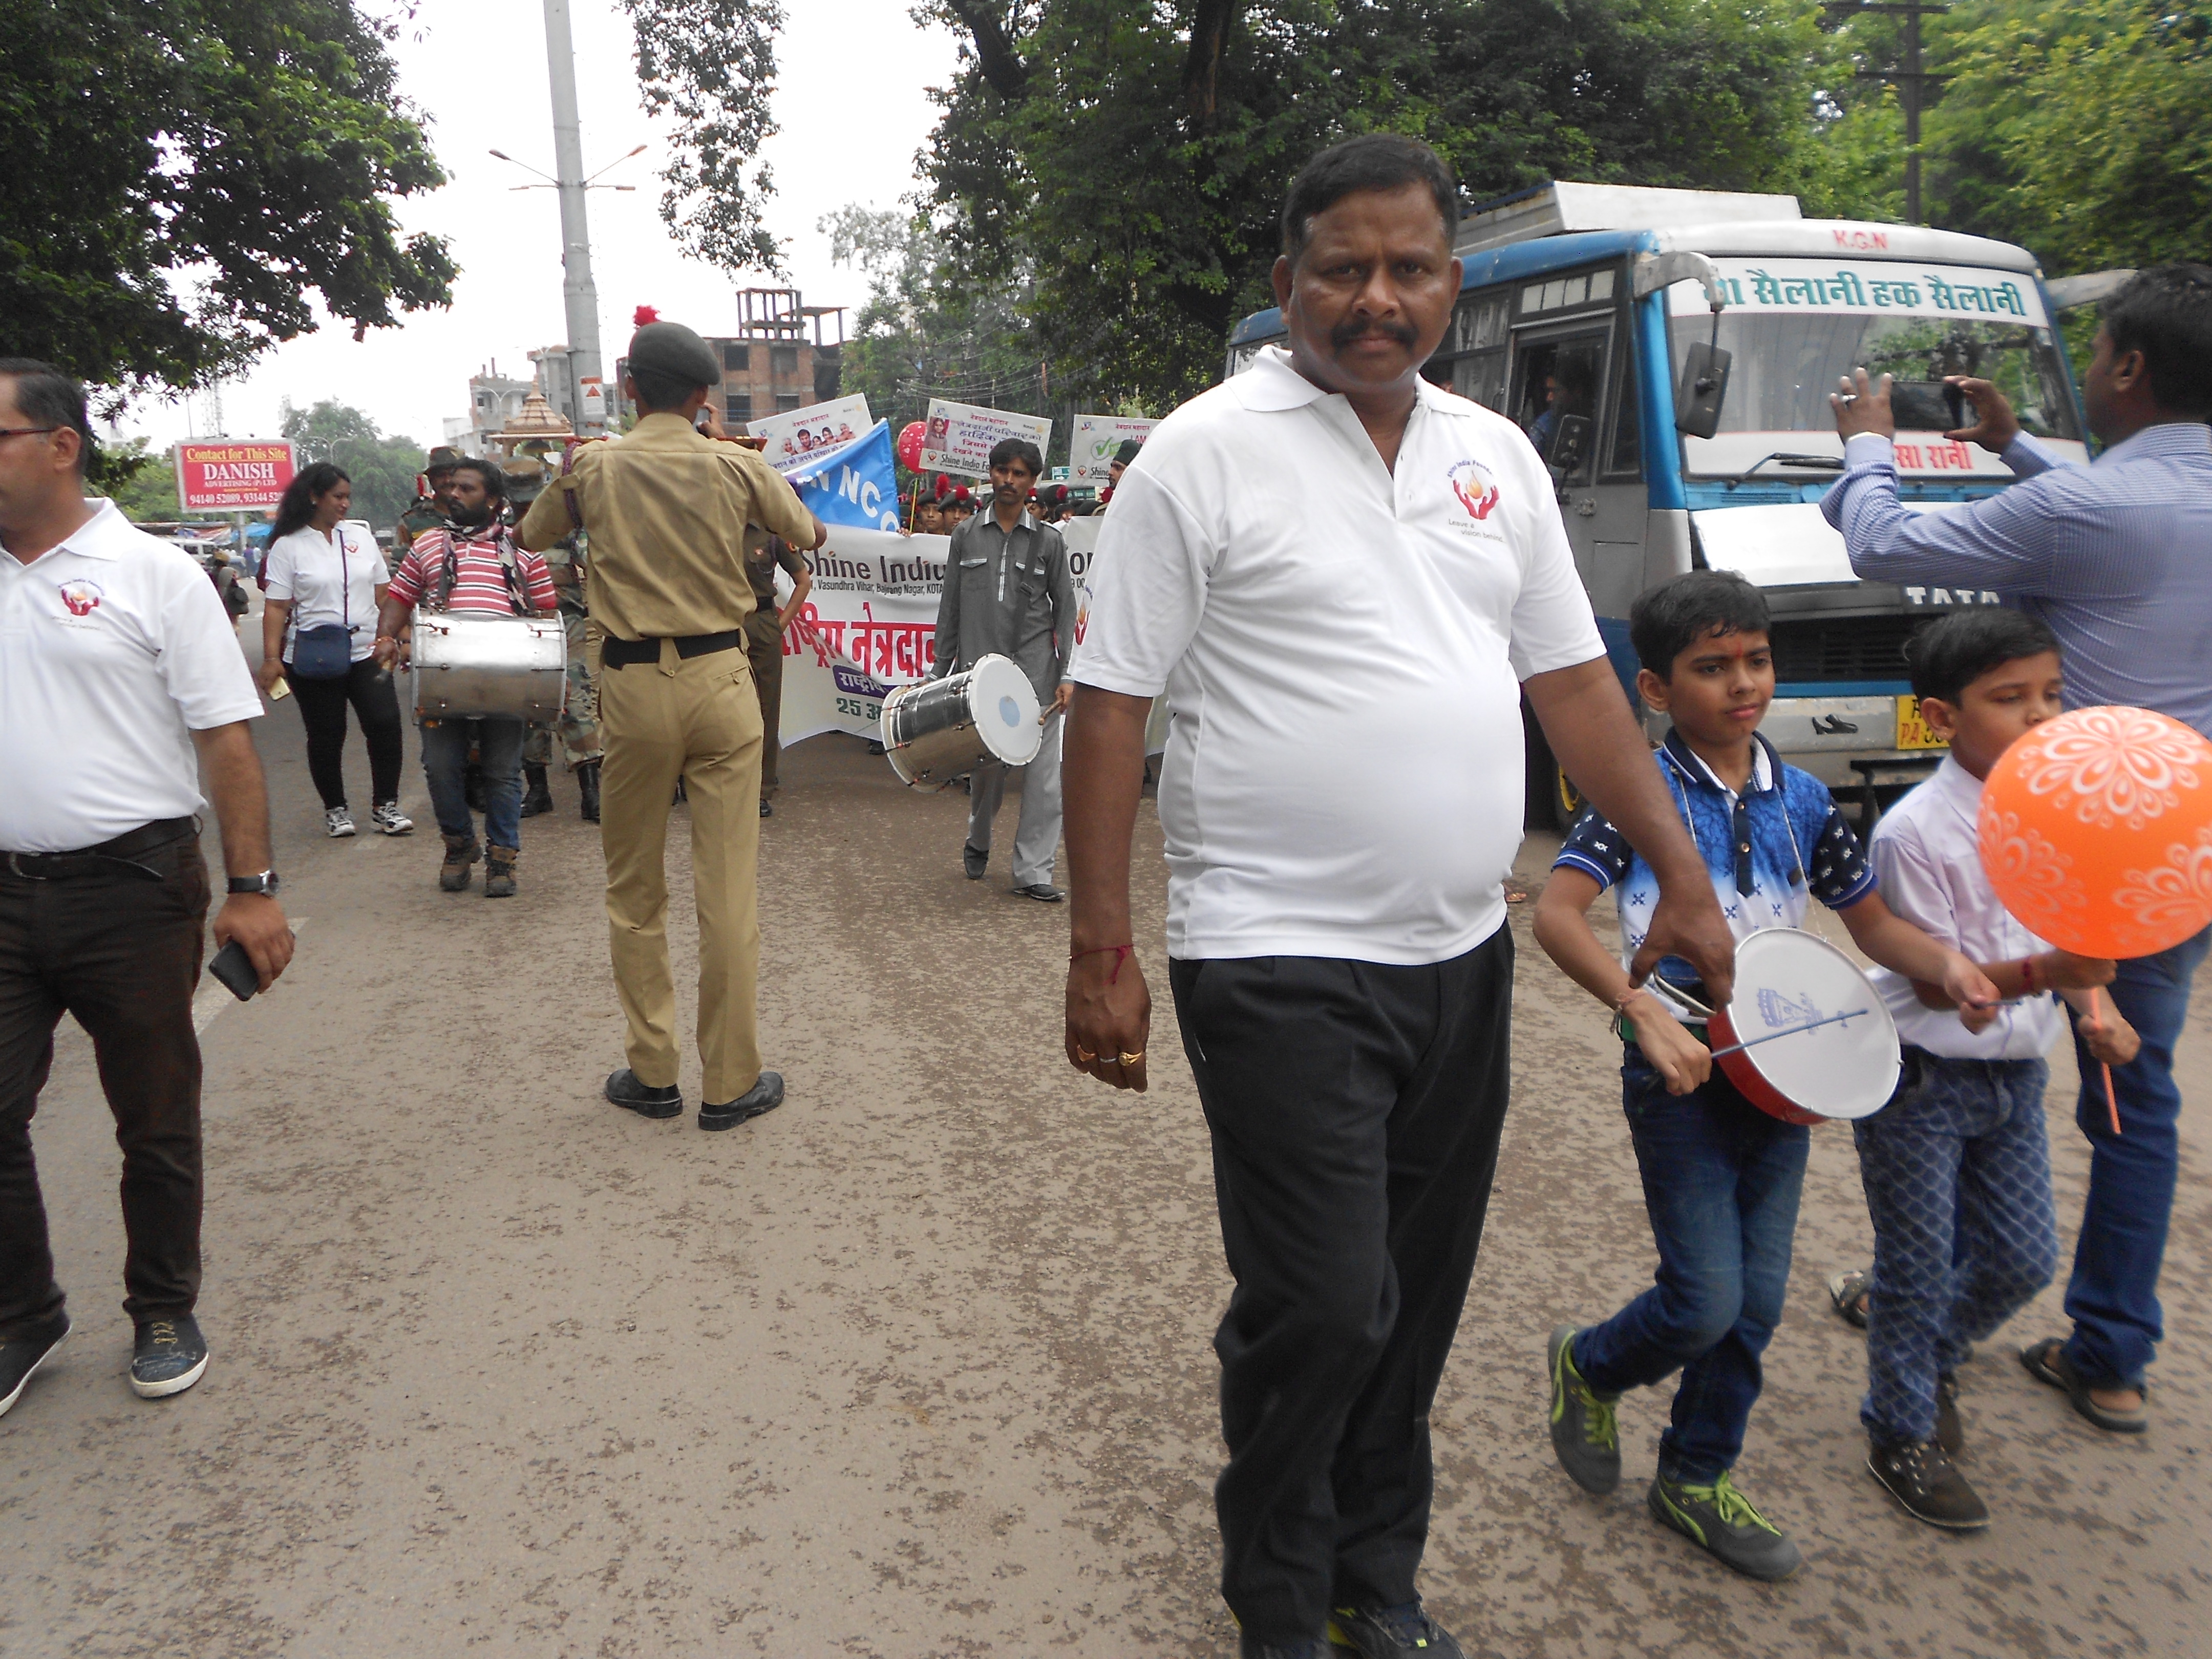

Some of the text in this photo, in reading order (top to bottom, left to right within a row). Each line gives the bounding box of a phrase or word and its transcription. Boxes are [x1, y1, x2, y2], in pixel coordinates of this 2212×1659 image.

[1833, 229, 1888, 250] K.G.N
[1746, 268, 1868, 307] सैलानी
[1868, 278, 1921, 307] हक
[1924, 274, 2027, 316] सैलानी
[186, 448, 287, 460] Contact for This Site
[941, 454, 960, 465] Shine
[962, 458, 980, 469] India
[203, 463, 274, 480] DANISH
[1461, 529, 1481, 537] vision
[798, 548, 870, 580] Shine
[818, 580, 855, 591] Vasundhra
[856, 581, 875, 594] Vihar,
[876, 584, 902, 596] Bajrang
[904, 584, 925, 595] Nagar,
[1906, 587, 2000, 605] TATA
[836, 697, 861, 717] 25
